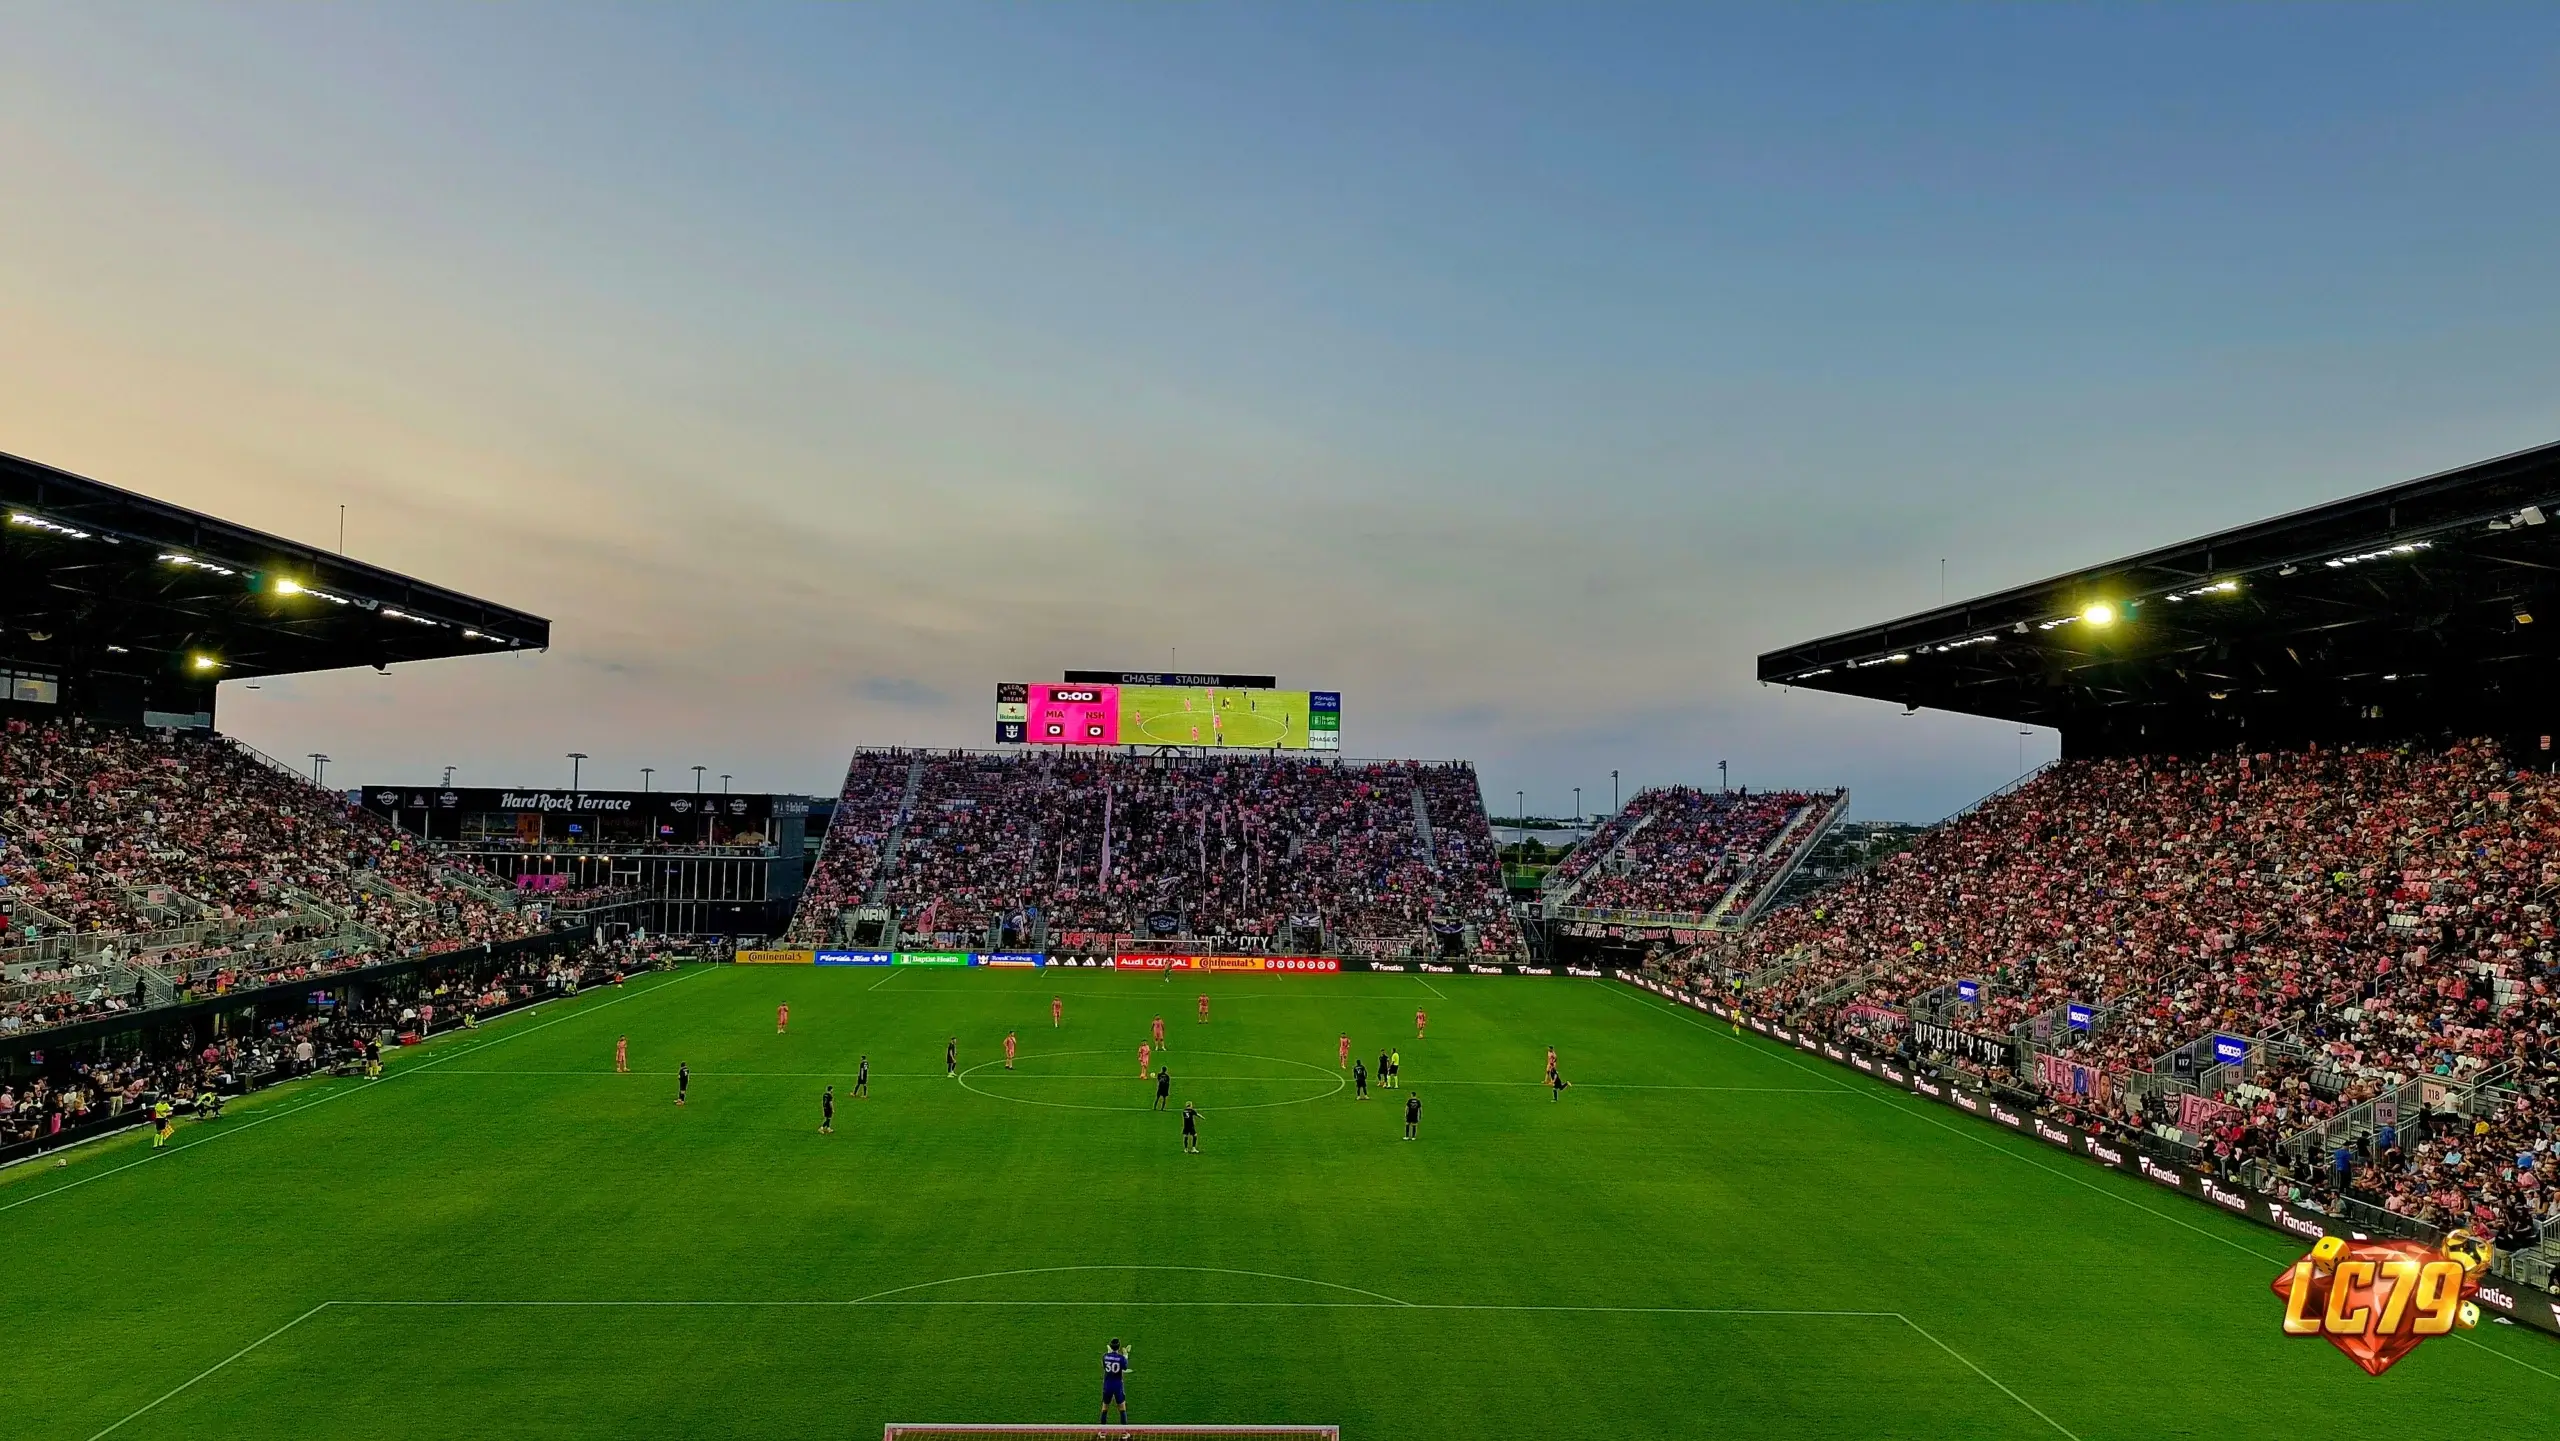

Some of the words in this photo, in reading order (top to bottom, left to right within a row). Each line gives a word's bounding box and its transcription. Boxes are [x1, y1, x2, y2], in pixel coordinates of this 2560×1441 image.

[1122, 674, 1161, 683] CHASE
[1175, 675, 1219, 685] STADIUM
[1057, 691, 1093, 700] 0:00
[1046, 710, 1064, 718] MIA
[1086, 711, 1105, 719] NSH
[1049, 726, 1061, 734] 0
[1090, 727, 1101, 736] 0
[501, 793, 538, 808] Hard
[538, 794, 573, 811] Rock
[577, 794, 631, 810] Terrace
[1240, 935, 1270, 950] CITY
[1120, 958, 1143, 966] Audi
[1527, 967, 1552, 975] Fanatics
[1914, 1021, 1944, 1050] VICE
[1945, 1028, 1974, 1057] CITY
[2178, 1058, 2190, 1067] 117
[2227, 1070, 2240, 1079] 118
[2428, 1089, 2440, 1101] 118
[1957, 1093, 1977, 1111] Fanatics
[1996, 1108, 2020, 1126] Fanatics
[2379, 1108, 2392, 1118] 118
[2042, 1124, 2068, 1144] Fanatics
[2094, 1144, 2122, 1164] Fanatics
[2149, 1163, 2180, 1185] Fanatics
[2212, 1185, 2246, 1210] Fanatics
[2282, 1211, 2324, 1238] Fanatics
[1105, 1361, 1120, 1373] 30
